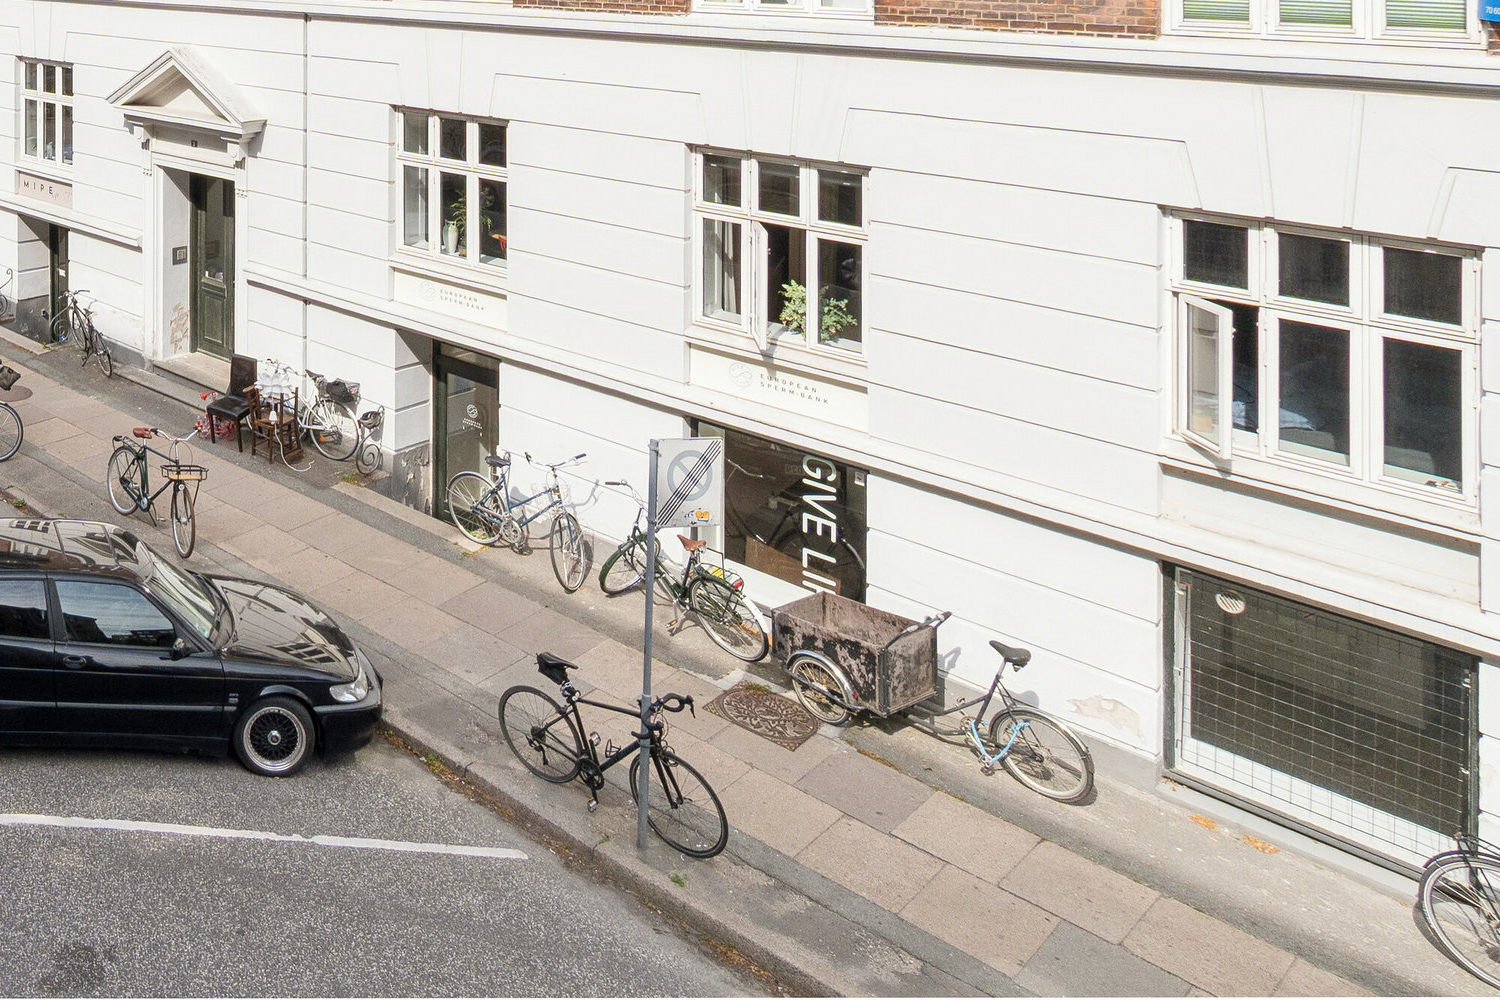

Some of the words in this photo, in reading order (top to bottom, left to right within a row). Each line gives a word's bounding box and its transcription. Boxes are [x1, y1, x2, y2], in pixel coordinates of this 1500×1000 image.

[23, 179, 54, 195] MIPE
[440, 288, 478, 303] EUROPEAN
[760, 373, 817, 393] EUROPEAN
[802, 454, 837, 544] GIVE
